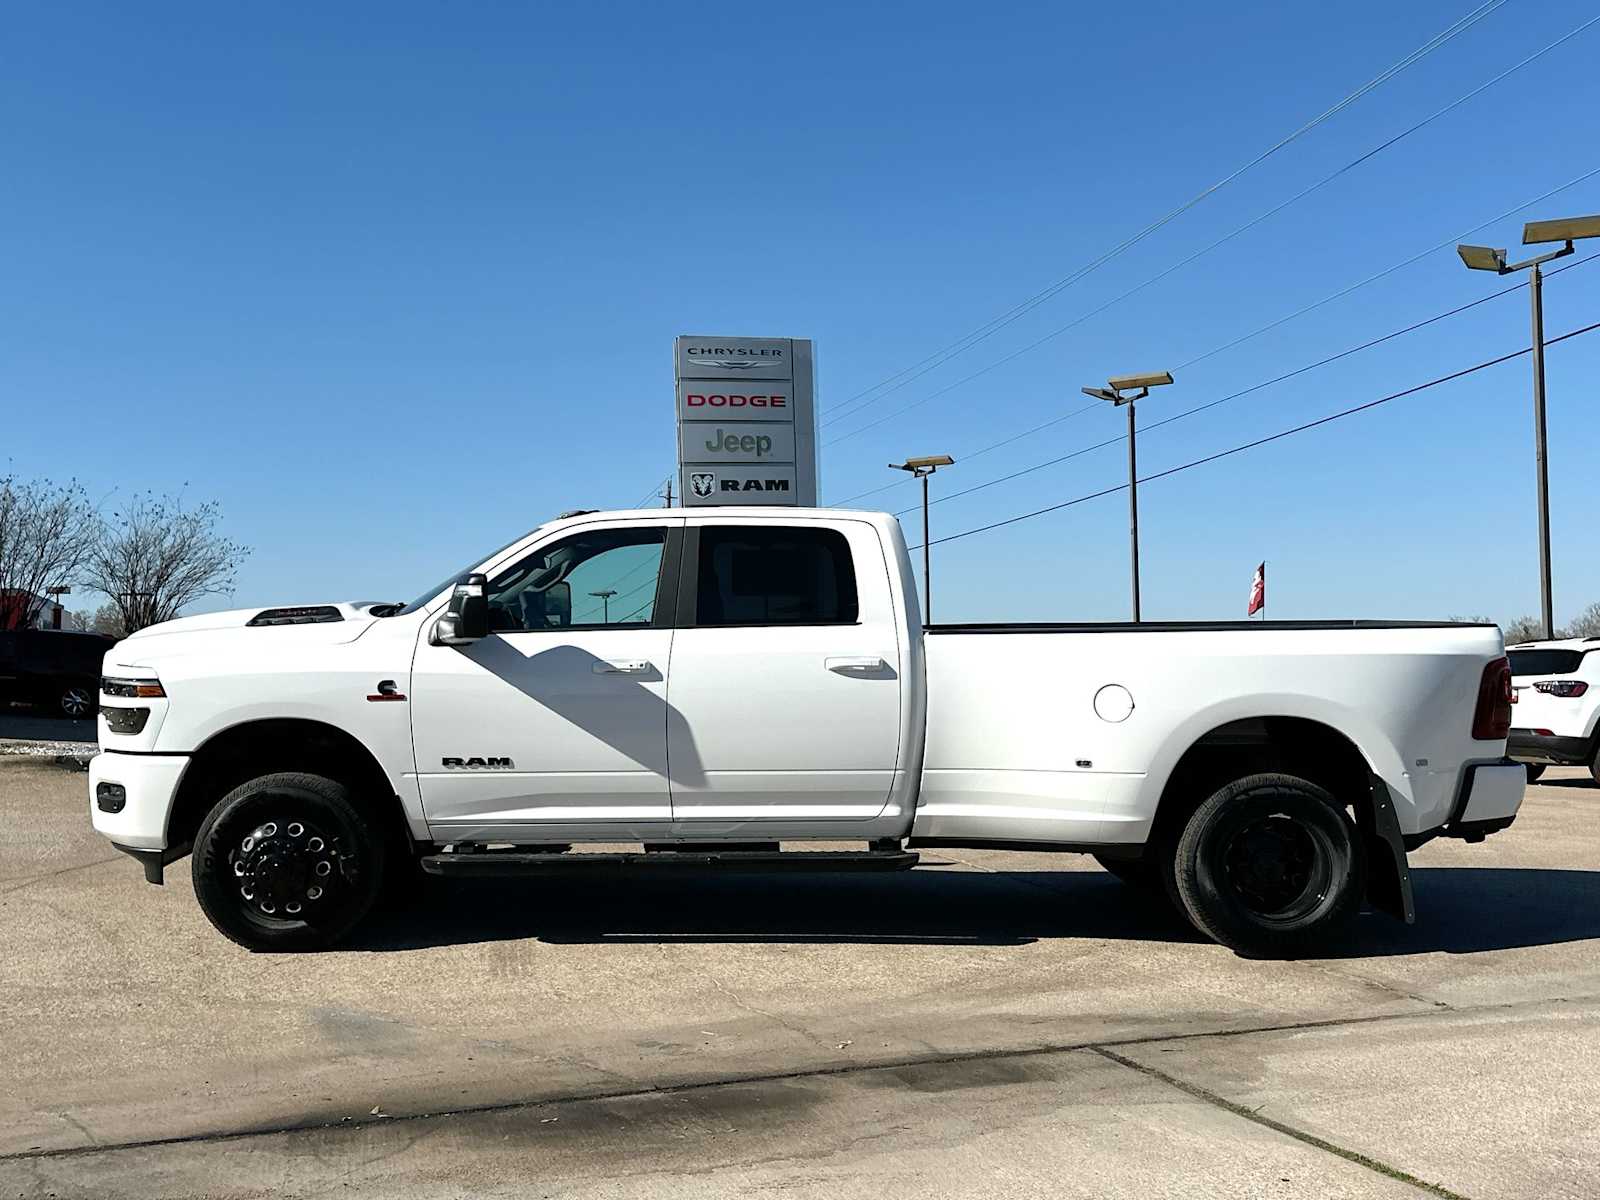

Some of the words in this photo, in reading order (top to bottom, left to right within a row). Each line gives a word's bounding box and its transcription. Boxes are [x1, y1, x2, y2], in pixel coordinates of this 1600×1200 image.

[687, 348, 782, 357] CHRYSLER
[687, 395, 786, 407] DODGE
[705, 429, 772, 456] Jeep
[720, 479, 789, 491] RAM
[441, 757, 512, 767] RAM
